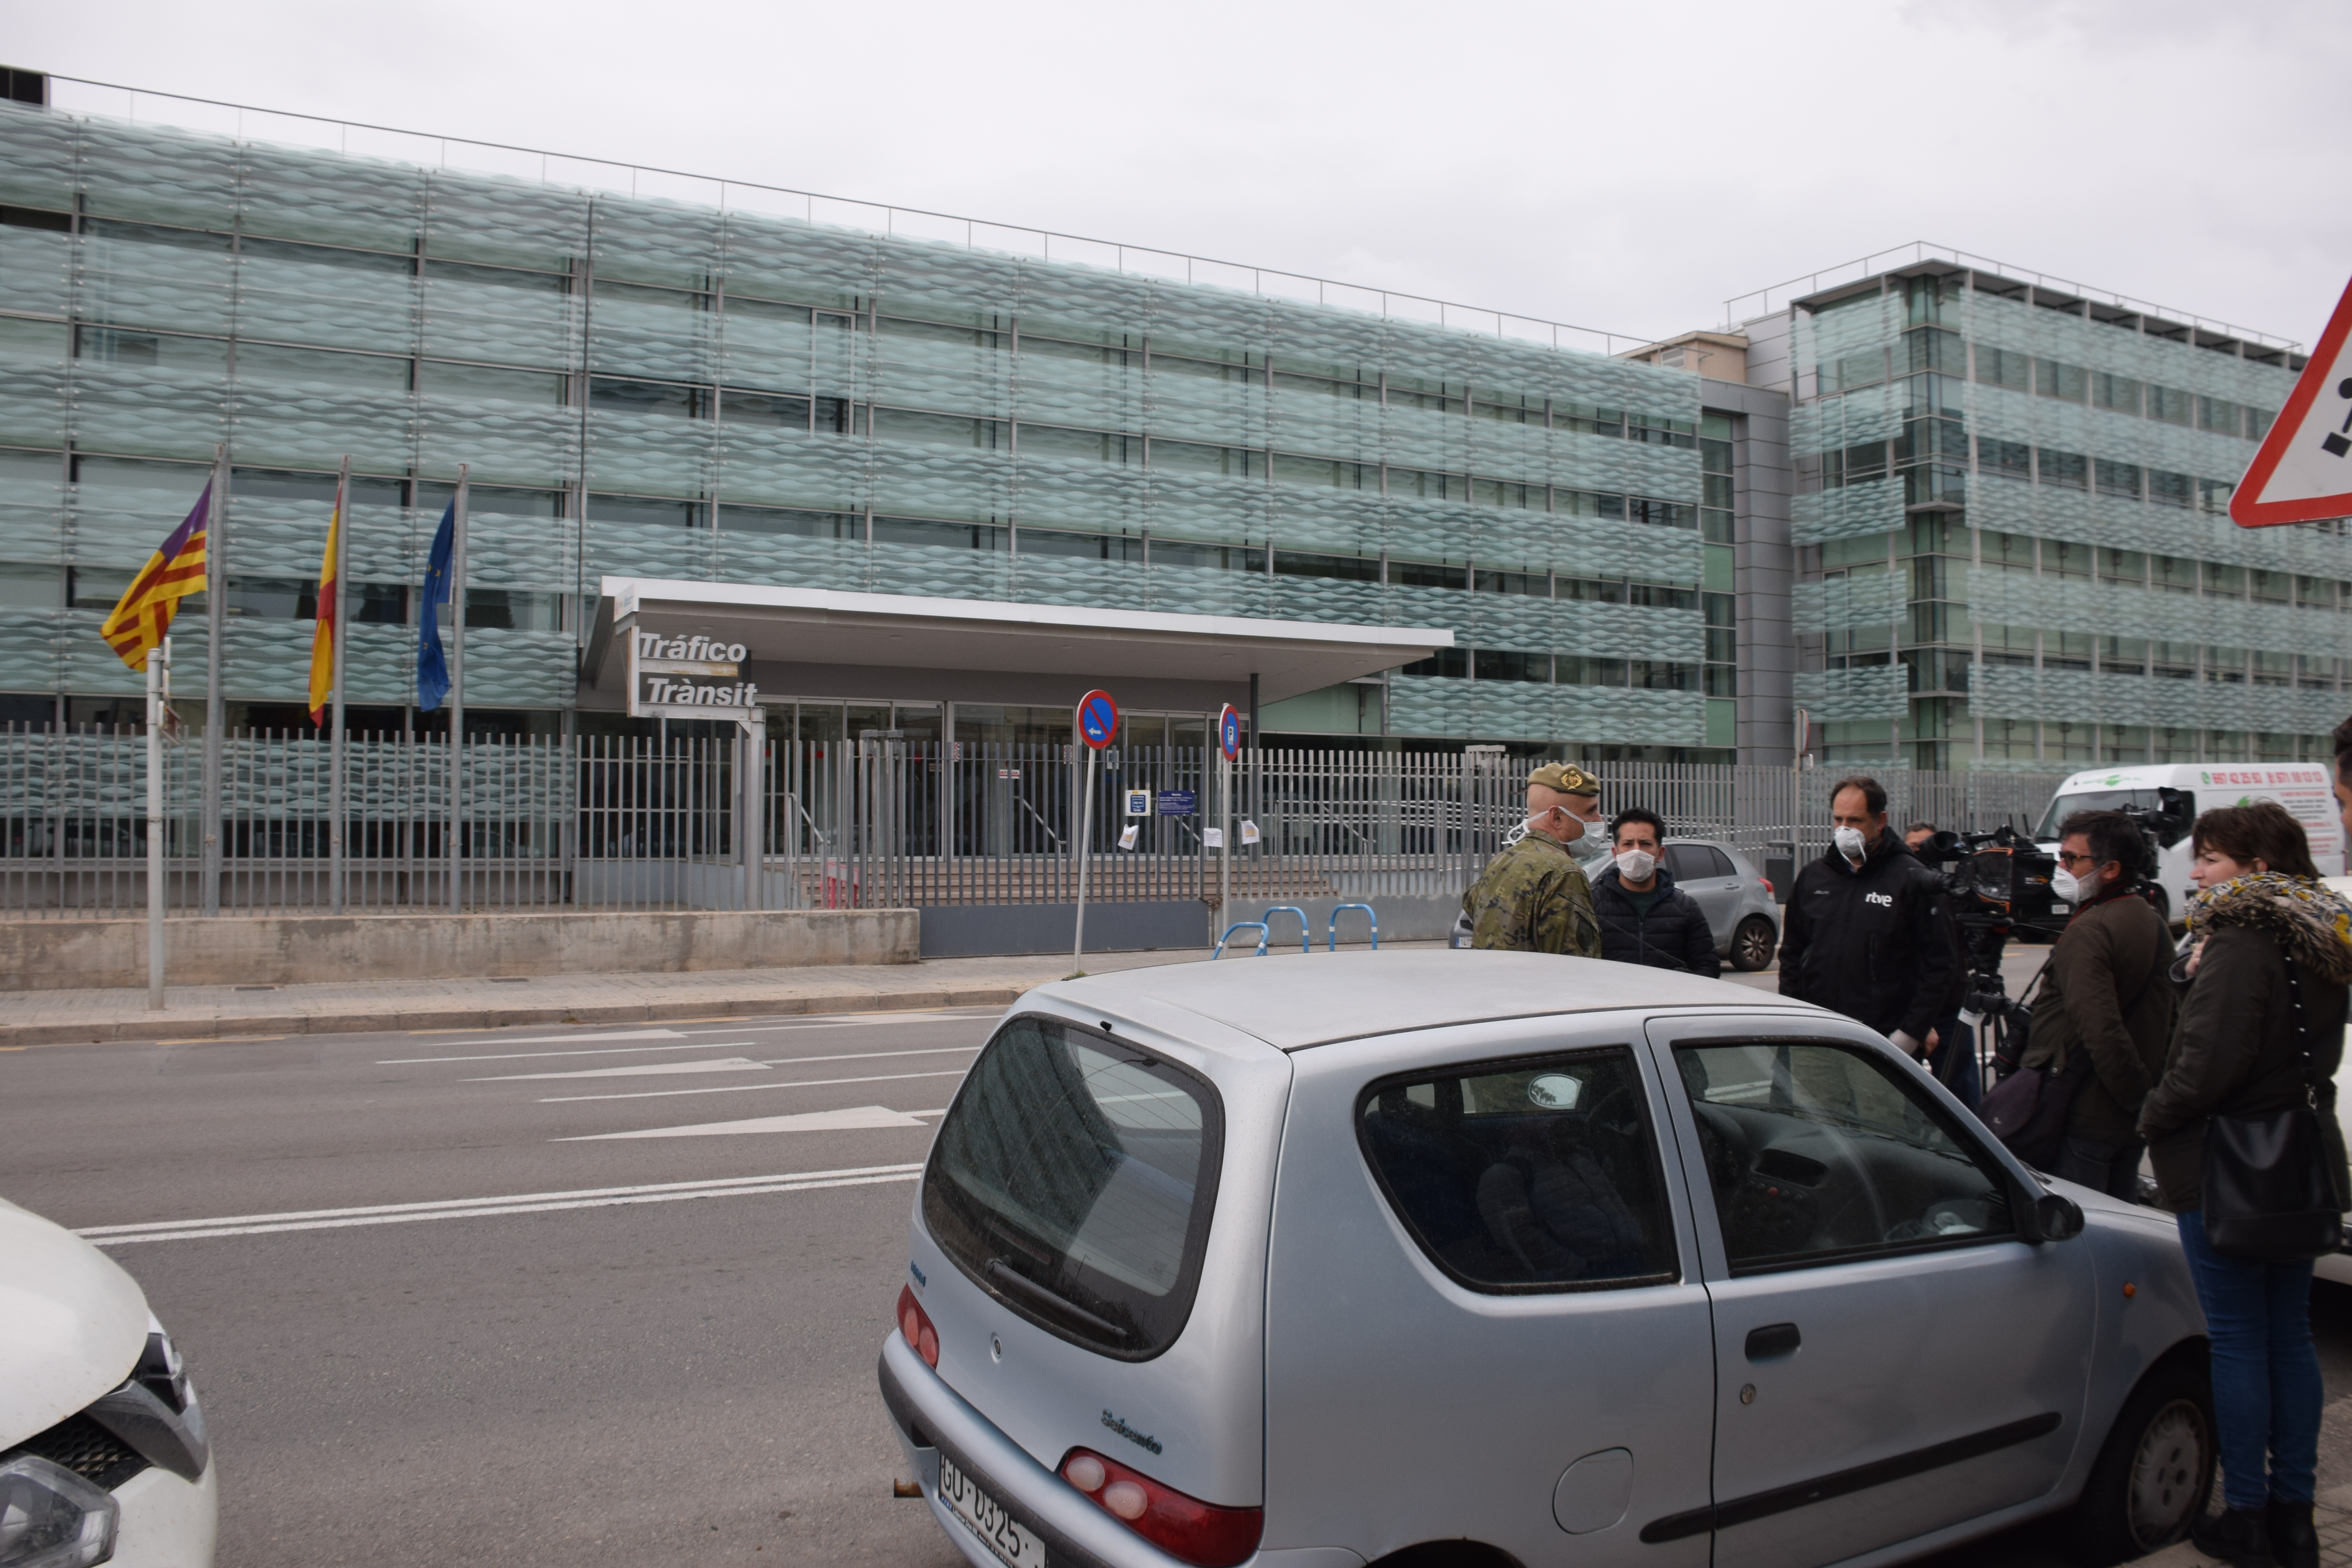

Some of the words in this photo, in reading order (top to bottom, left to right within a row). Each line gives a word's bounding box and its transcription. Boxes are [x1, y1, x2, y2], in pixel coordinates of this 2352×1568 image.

[639, 632, 747, 662] Tráfico
[647, 678, 758, 706] Trànsit
[1865, 891, 1893, 907] rtve
[1101, 1408, 1162, 1455] Seicento
